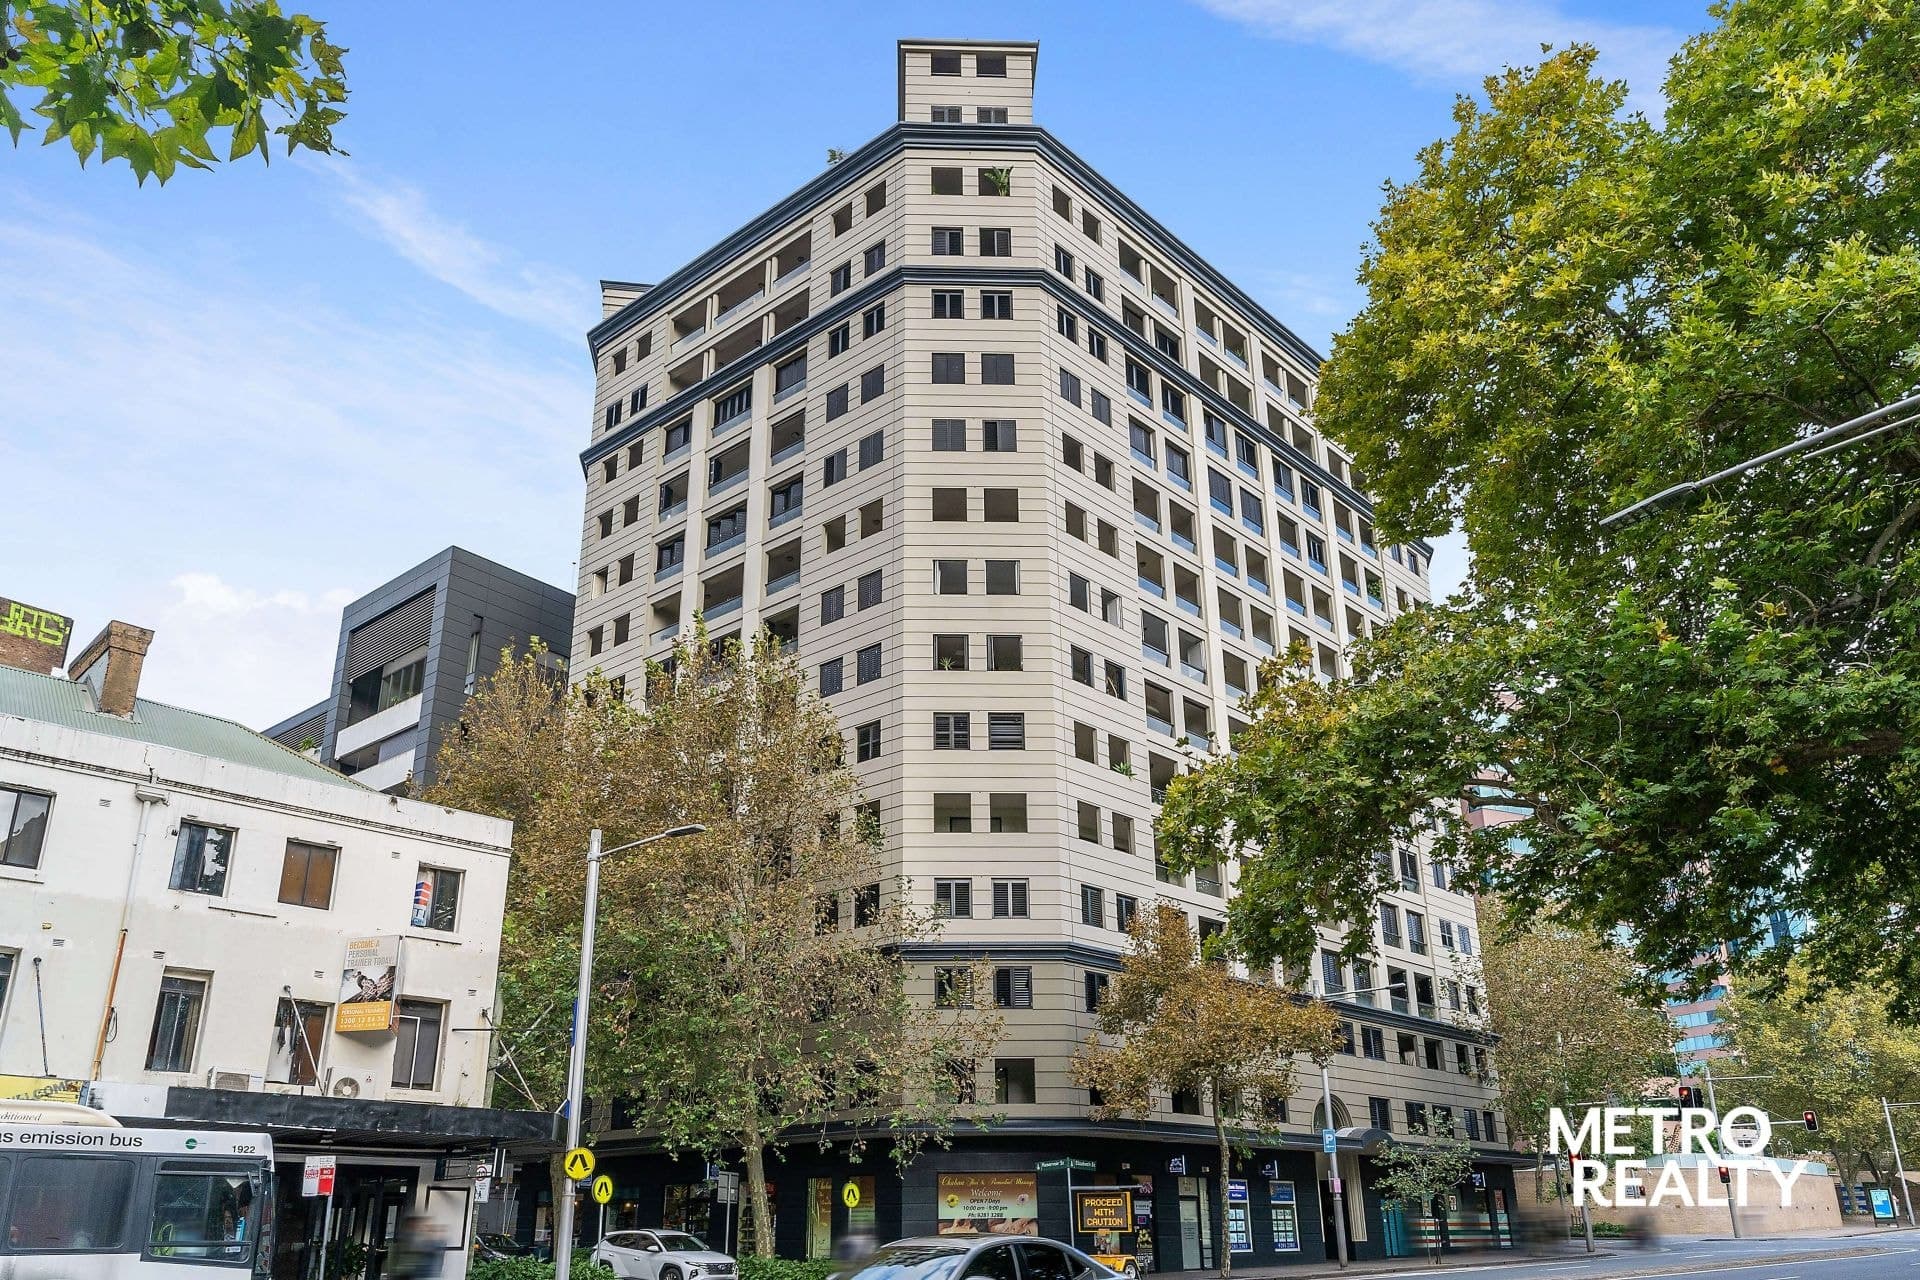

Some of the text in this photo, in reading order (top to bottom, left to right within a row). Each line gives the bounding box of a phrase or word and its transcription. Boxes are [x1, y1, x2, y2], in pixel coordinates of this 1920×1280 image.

[349, 940, 374, 949] BECOME
[348, 949, 378, 958] PERSONAL
[347, 959, 372, 967] TRAINER
[20, 1130, 104, 1145] emission
[110, 1133, 143, 1147] bus
[1325, 1133, 1334, 1144] P
[232, 1145, 256, 1153] 1922
[971, 1187, 1003, 1197] Welcome
[1085, 1198, 1123, 1207] PROCEED
[1094, 1208, 1115, 1216] WITH
[1087, 1218, 1123, 1226] CAUTION
